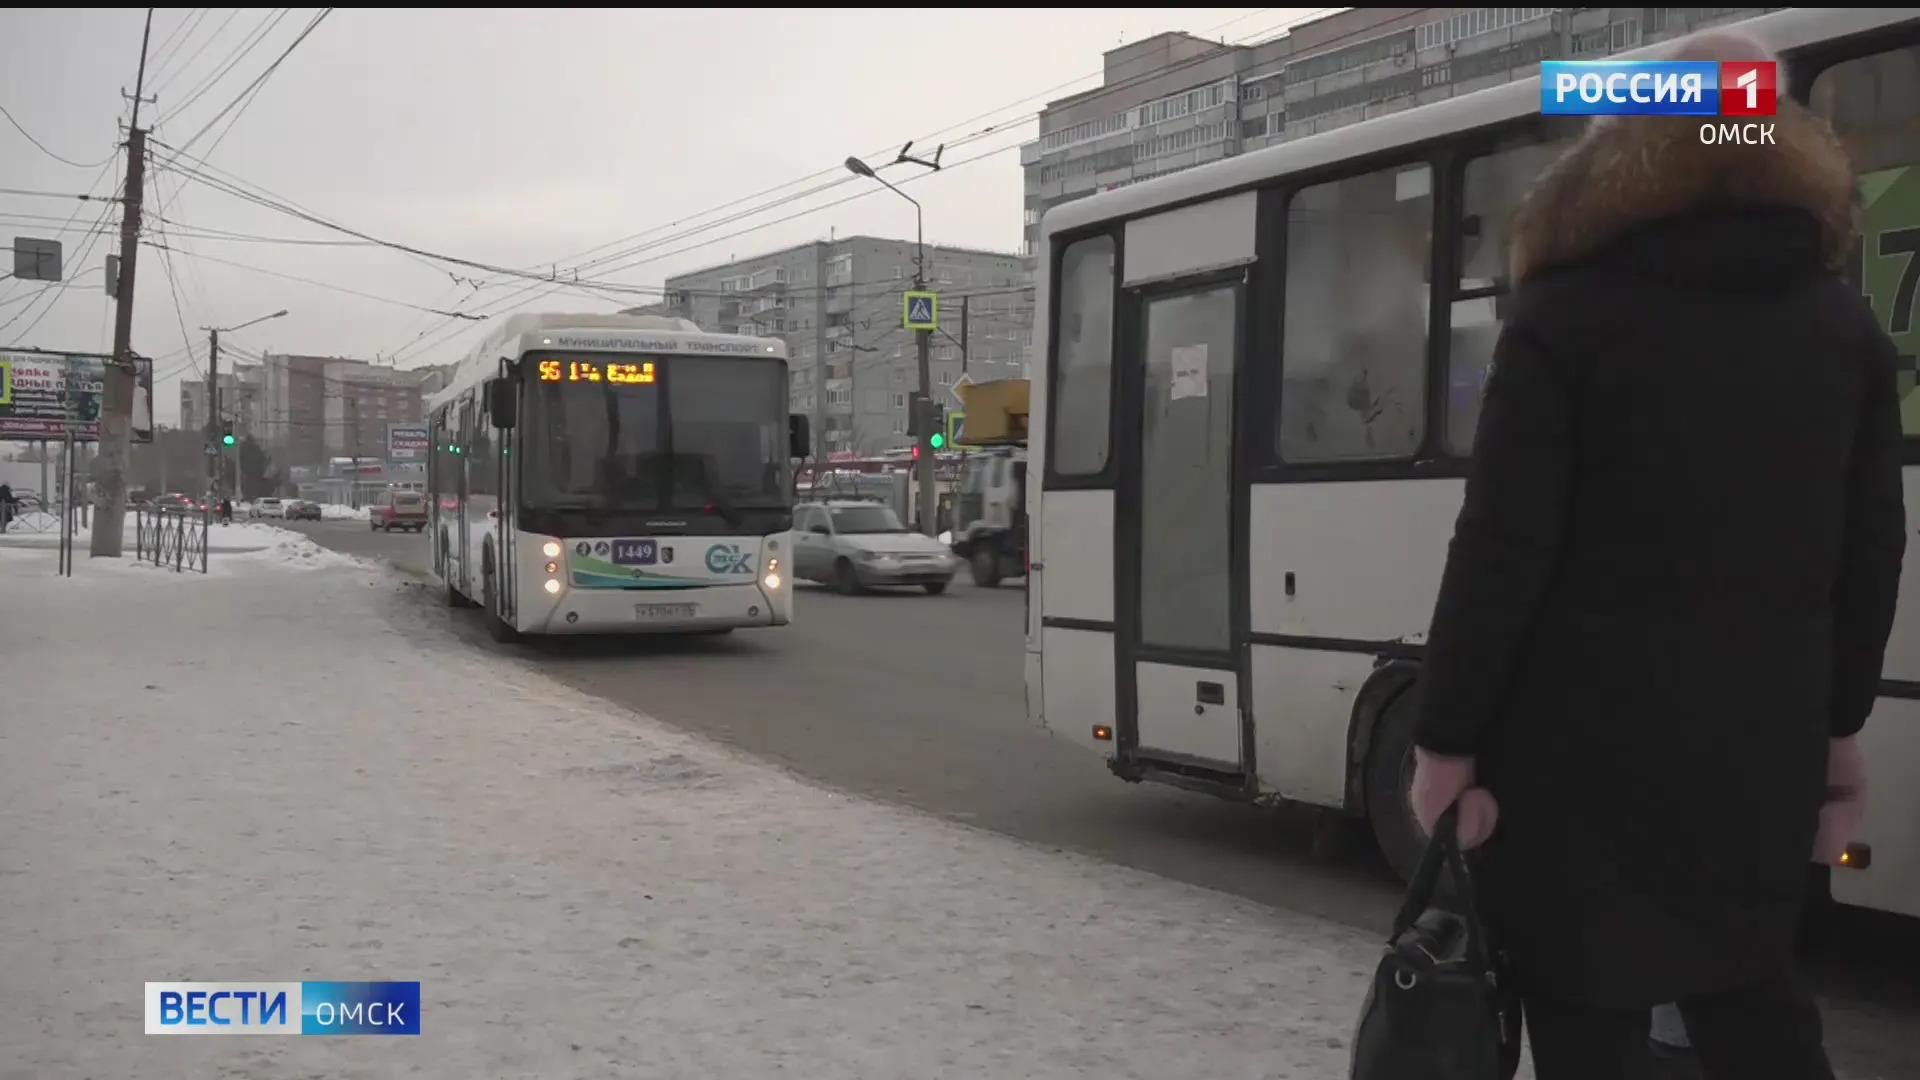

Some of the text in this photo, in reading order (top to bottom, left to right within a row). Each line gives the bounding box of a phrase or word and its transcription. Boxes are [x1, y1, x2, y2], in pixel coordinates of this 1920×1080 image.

[558, 337, 759, 353] МУНИЦИПАЛЬНЫЙ ТРАНСПОРТ
[618, 545, 652, 560] 1449
